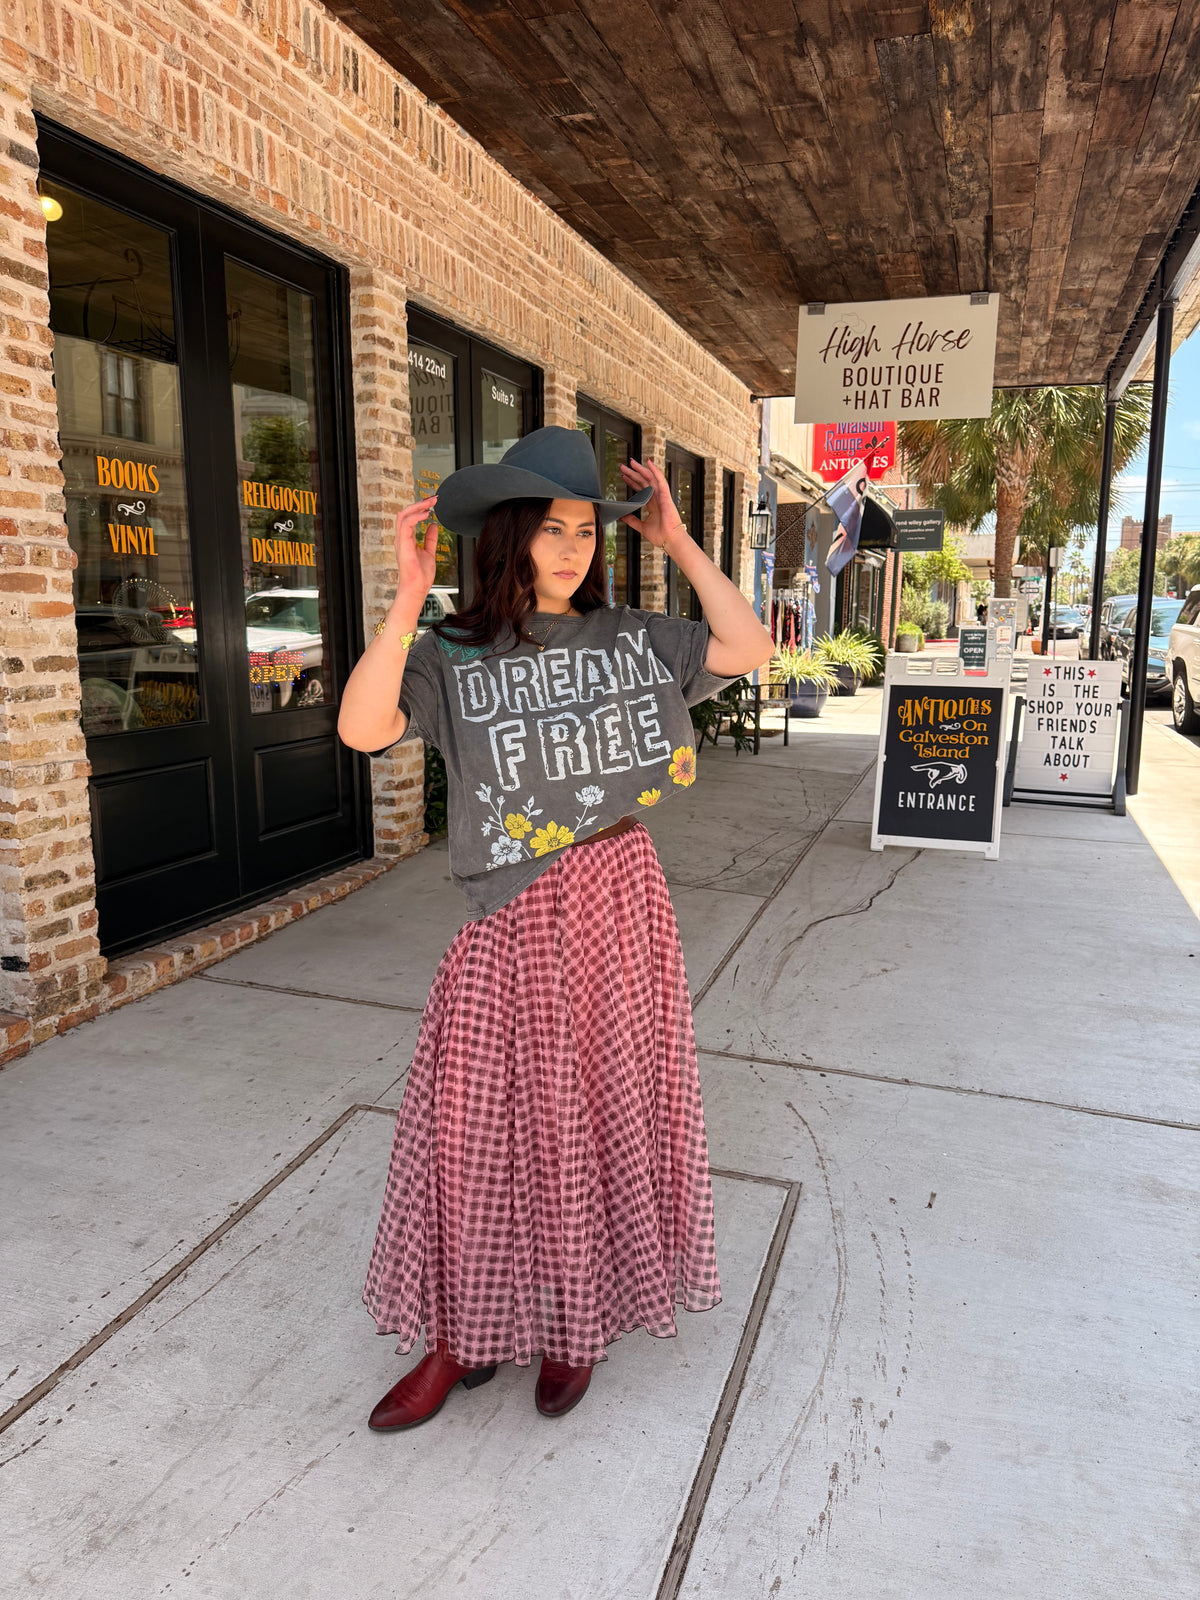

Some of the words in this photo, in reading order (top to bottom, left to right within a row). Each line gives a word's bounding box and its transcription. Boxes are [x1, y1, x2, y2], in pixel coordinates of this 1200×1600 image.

[819, 324, 882, 363] High
[891, 321, 974, 361] Horse
[425, 357, 446, 379] 22nd
[842, 363, 945, 388] BOUTIQUE
[491, 385, 509, 405] Suite
[509, 394, 515, 407] 2
[901, 387, 941, 409] BAR
[825, 430, 863, 457] Rouge
[819, 455, 889, 471] ANTIQES
[96, 455, 160, 494] BOOKS
[243, 480, 318, 516] RELIGIOSITY
[108, 523, 159, 556] VINYL
[251, 537, 317, 567] DISHWARE
[249, 664, 303, 683] OPEN
[452, 629, 674, 722] DREAM
[1054, 665, 1086, 680] THIS
[1043, 684, 1056, 698] IS
[1074, 685, 1099, 699] THE
[897, 696, 992, 727] ANTIQUES
[1028, 700, 1064, 715] SHOP
[1076, 702, 1112, 717] YOUR
[962, 719, 987, 732] On
[1037, 718, 1097, 734] FRIENDS
[488, 693, 672, 791] FREE
[899, 730, 989, 746] Galveston
[1051, 736, 1084, 750] TALK
[913, 745, 970, 760] Island
[1043, 753, 1090, 769] ABOUT
[898, 791, 976, 812] ENTRANCE
